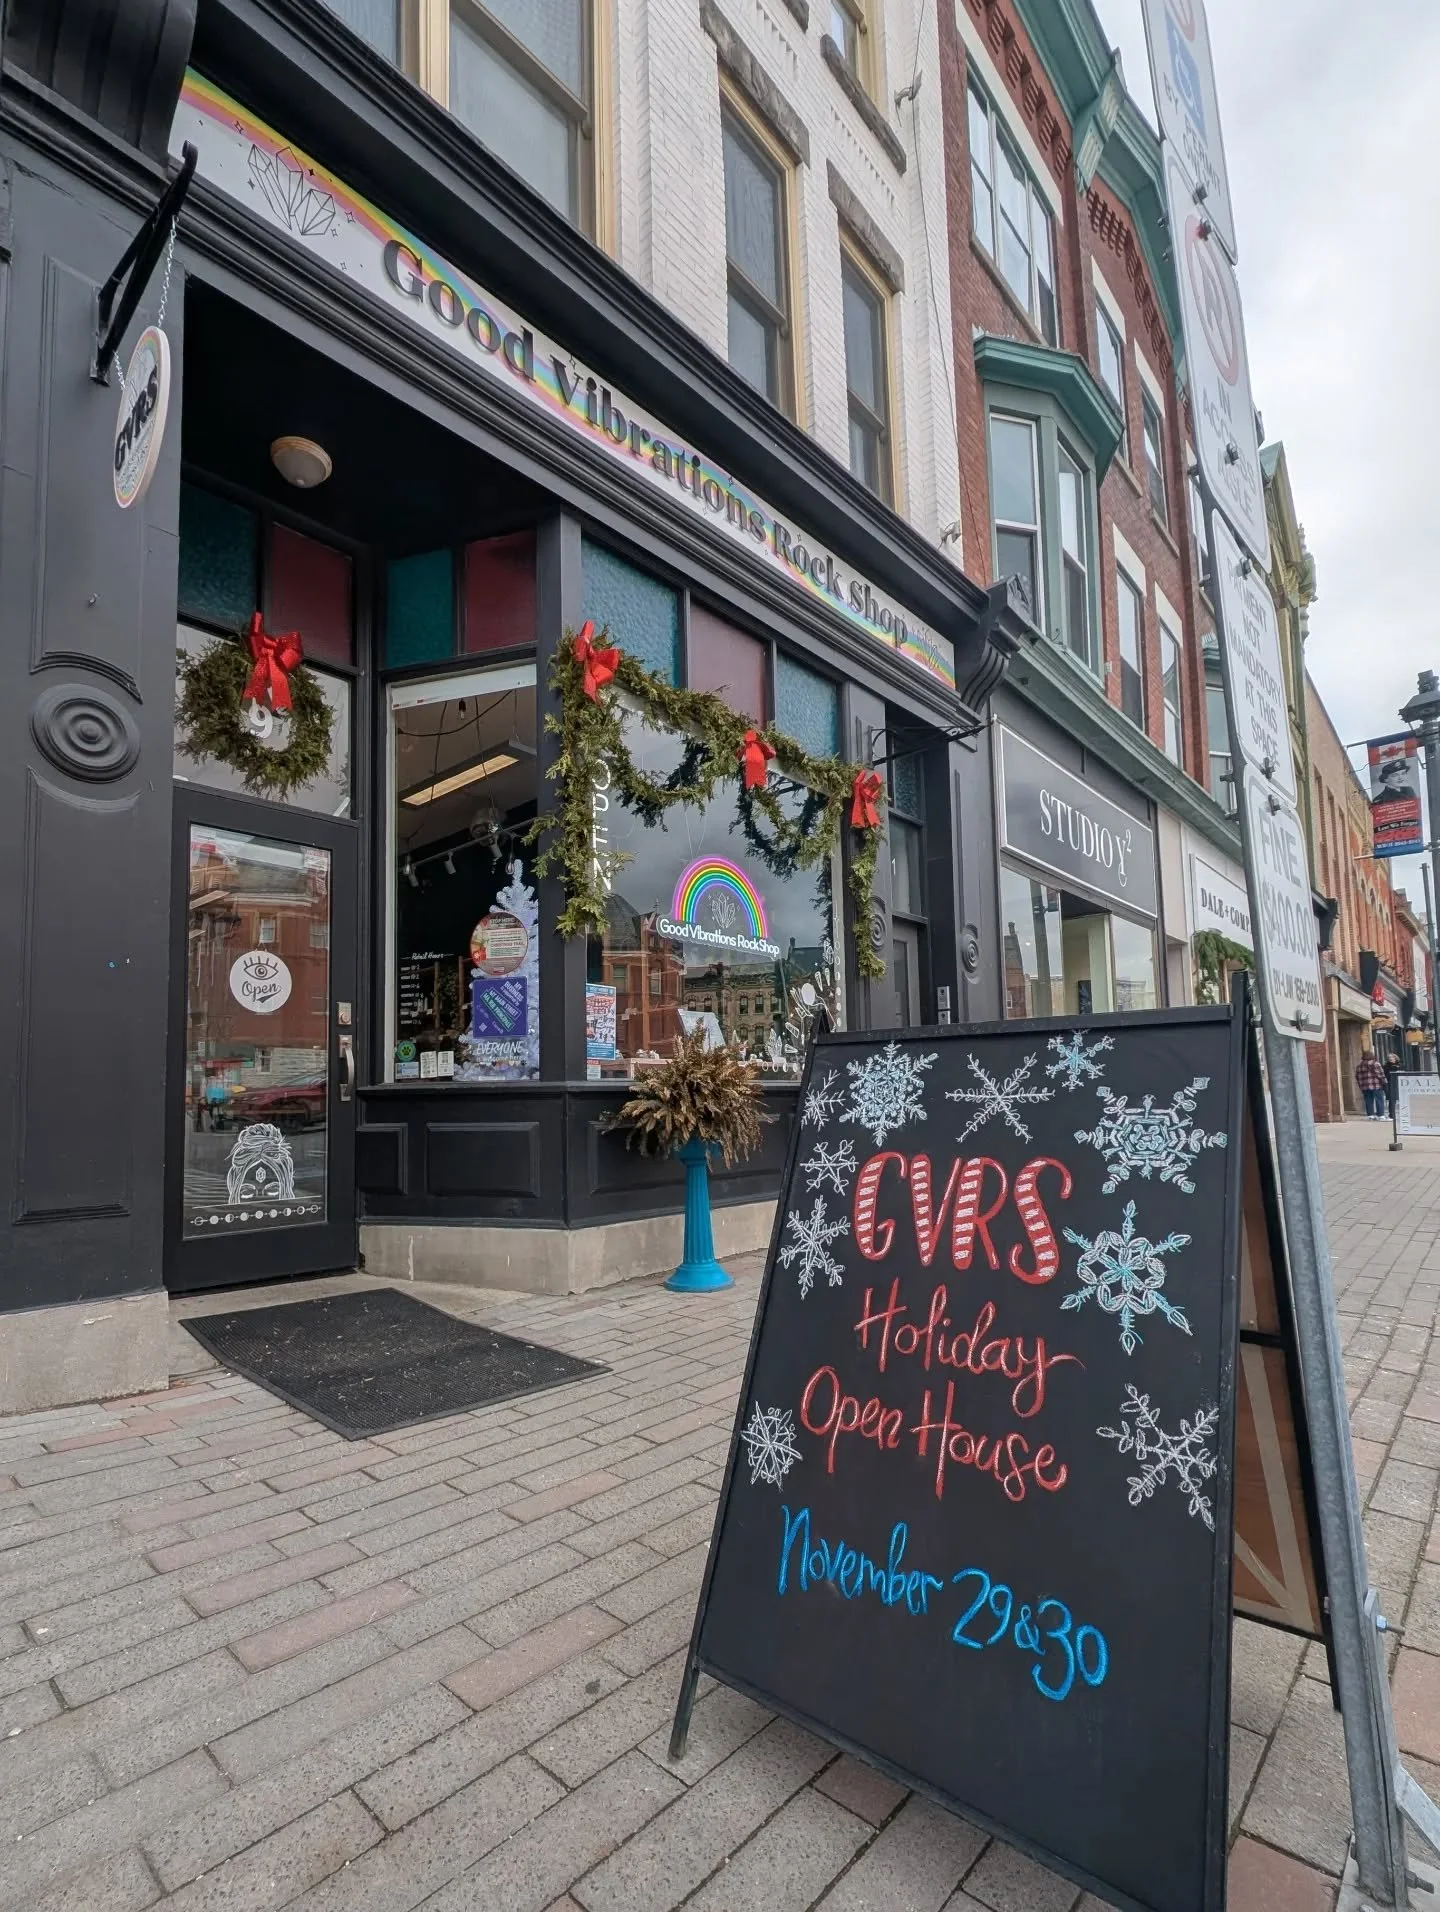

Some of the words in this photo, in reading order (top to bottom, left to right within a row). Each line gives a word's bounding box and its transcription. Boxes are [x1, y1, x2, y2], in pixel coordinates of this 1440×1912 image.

[1185, 114, 1221, 197] PERMIT
[114, 365, 158, 472] GVRS
[1216, 376, 1233, 425] IN
[382, 239, 536, 385] Good
[549, 353, 769, 545] Vibrations
[771, 519, 843, 603] Rock
[848, 579, 909, 649] Shop
[1228, 621, 1282, 708] MANDATORY
[1242, 610, 1260, 652] NOT
[249, 702, 273, 739] 9
[1245, 675, 1255, 709] AT
[1256, 689, 1279, 735] THIS
[1250, 714, 1281, 768] SPACE
[891, 858, 896, 876] 1
[1039, 788, 1113, 868] STUDIO
[1257, 806, 1302, 890] FINE
[660, 919, 689, 937] Good
[688, 923, 737, 947] Vibrations
[737, 934, 760, 951] Rock
[759, 939, 780, 958] Shop
[1200, 887, 1224, 918] DALE
[1262, 875, 1315, 962] $400.00
[241, 980, 282, 1003] Open
[476, 1040, 525, 1056] EVERYONE
[854, 1151, 1073, 1285] GVRS
[854, 1277, 1087, 1418] Holiday
[801, 1365, 902, 1475] Open
[910, 1379, 1069, 1501] House
[776, 1504, 944, 1616] November
